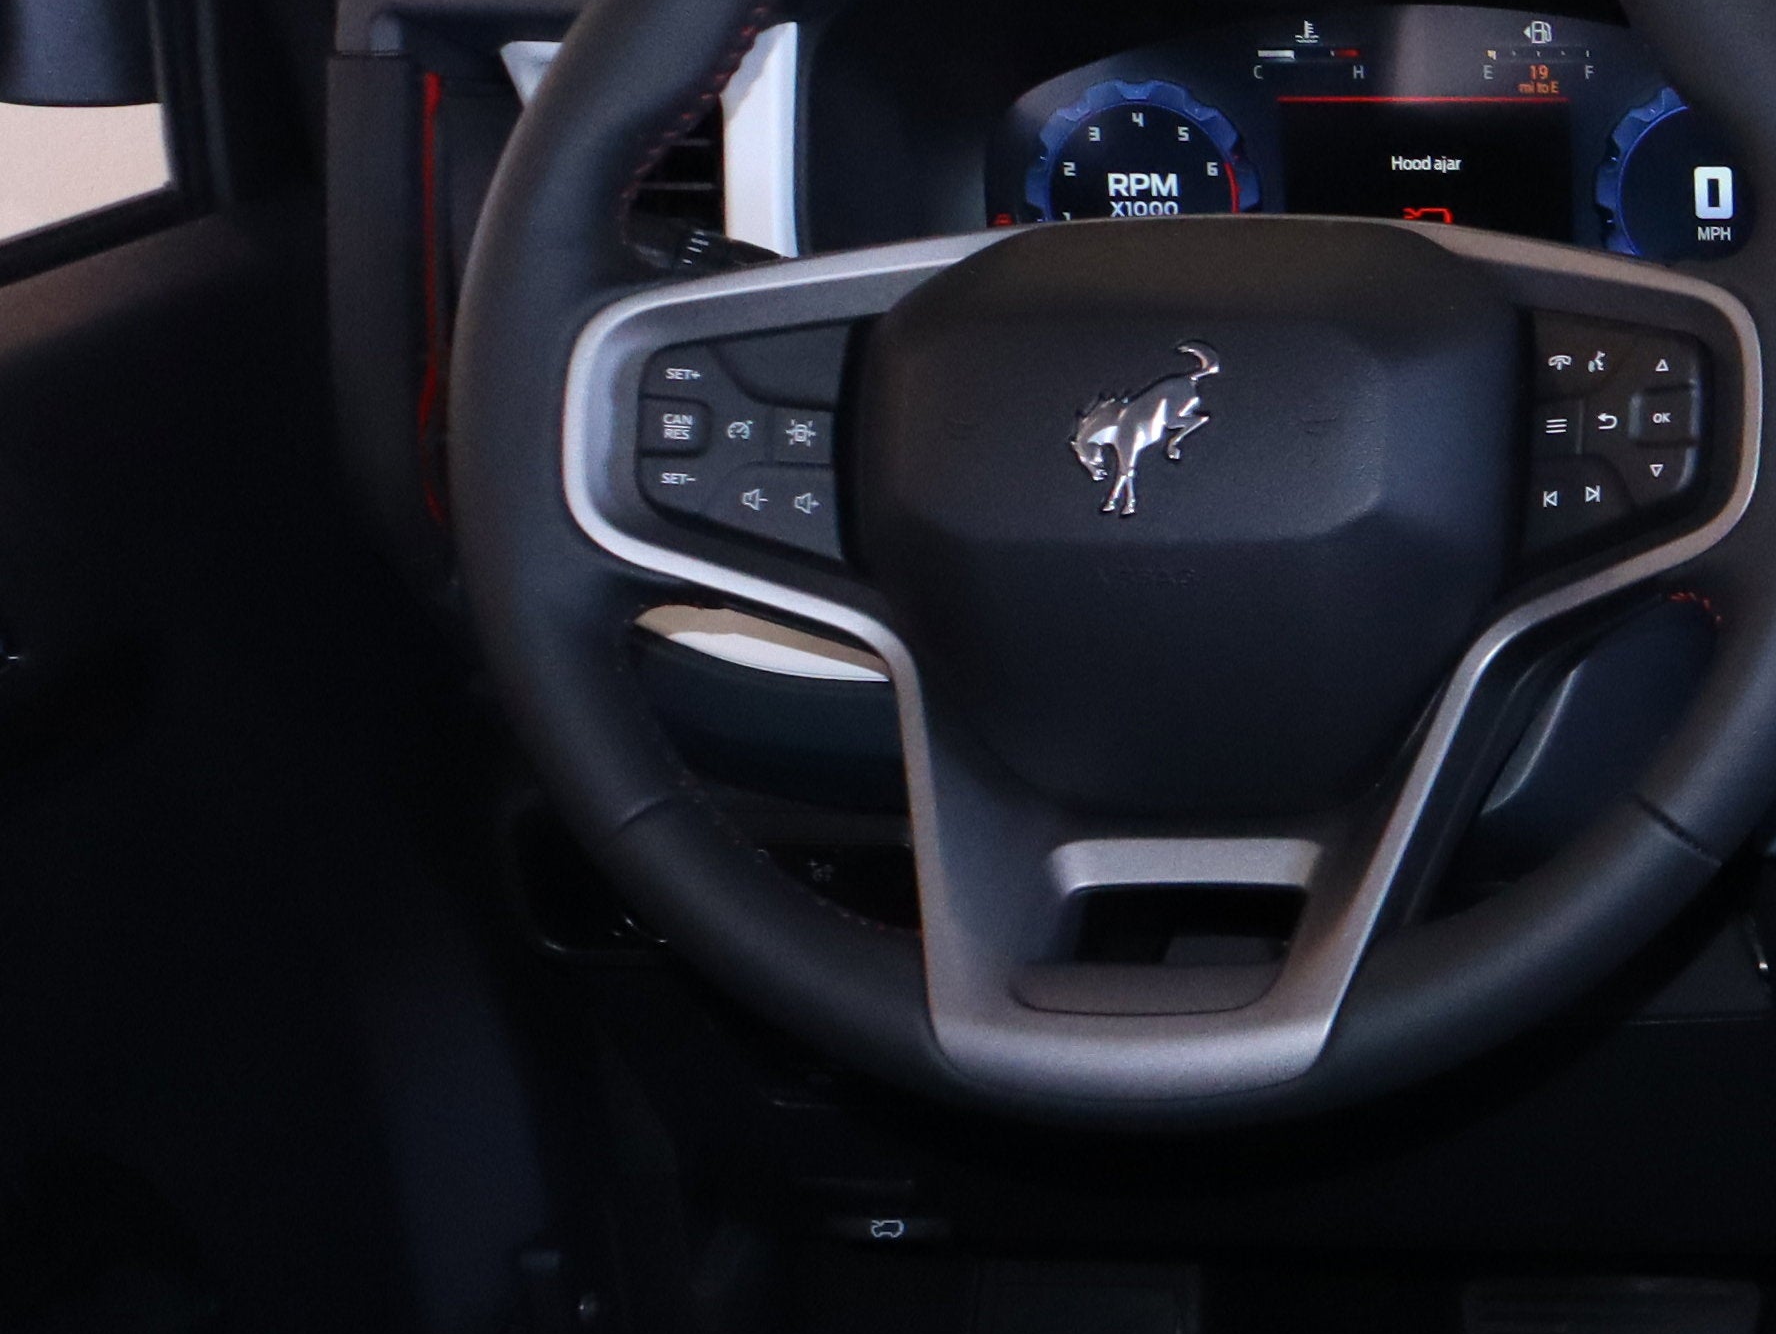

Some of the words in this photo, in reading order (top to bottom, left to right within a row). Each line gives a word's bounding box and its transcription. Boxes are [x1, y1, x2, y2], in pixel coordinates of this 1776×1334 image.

[1252, 65, 1264, 80] C
[1352, 65, 1365, 80] H
[1483, 65, 1494, 80] E
[1528, 64, 1550, 80] 19
[1584, 65, 1595, 80] F
[1517, 81, 1536, 94] mi
[1131, 111, 1145, 128] 4
[1088, 125, 1101, 142] 3
[1177, 125, 1191, 142] 5
[1062, 160, 1077, 177] 2
[1205, 161, 1219, 177] 6
[1390, 154, 1431, 171] Hood
[1433, 156, 1462, 174] ajar
[1107, 171, 1179, 198] RPM
[1693, 165, 1734, 220] 0
[1109, 200, 1179, 218] X1000
[1697, 225, 1732, 242] MPH
[664, 367, 702, 381] SET+
[662, 412, 694, 425] CAN
[1652, 412, 1672, 424] OK
[662, 428, 692, 441] RES
